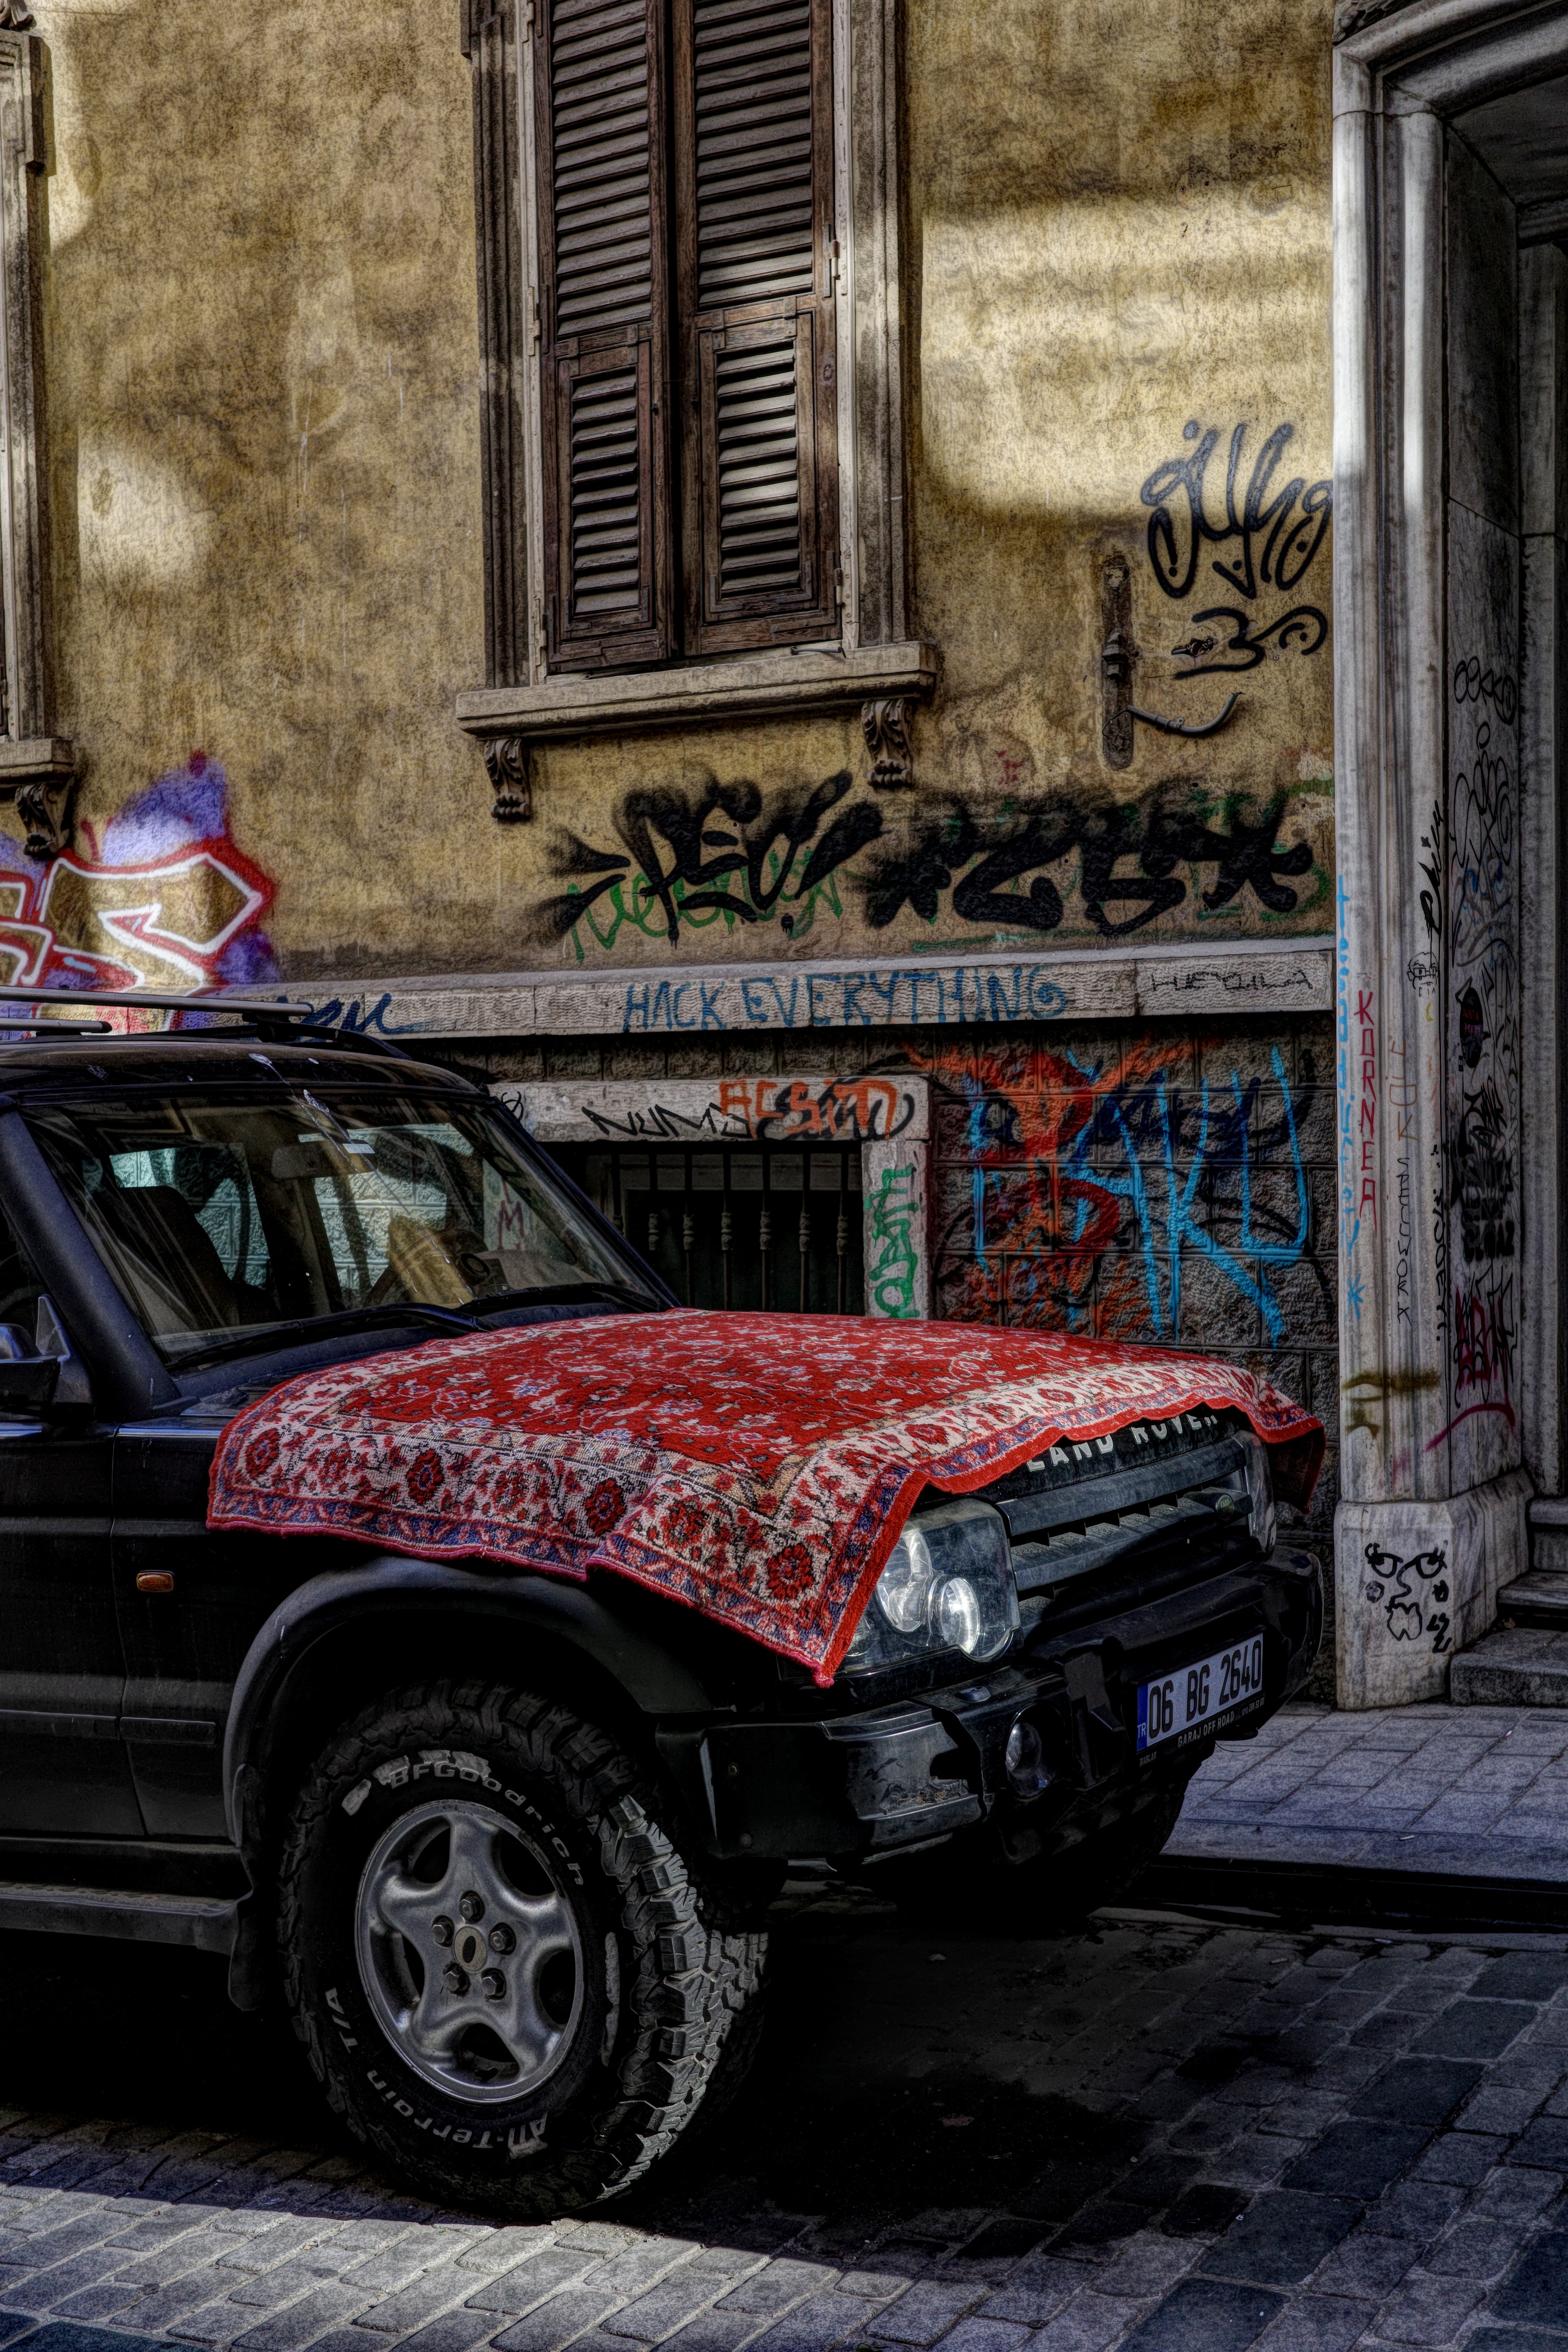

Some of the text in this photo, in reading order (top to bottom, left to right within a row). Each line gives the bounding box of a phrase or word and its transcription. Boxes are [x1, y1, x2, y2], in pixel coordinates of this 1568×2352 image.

[622, 966, 1067, 1033] HACK EVERYTHING
[1354, 990, 1377, 1236] KORNEA
[1149, 1640, 1261, 1739] 06 BG 2640
[1137, 1722, 1146, 1739] TR
[1177, 1727, 1201, 1749] GARAJ
[1203, 1720, 1216, 1737] OFF
[1217, 1710, 1234, 1730] ROAD
[367, 2069, 548, 2151] All-Terrain
